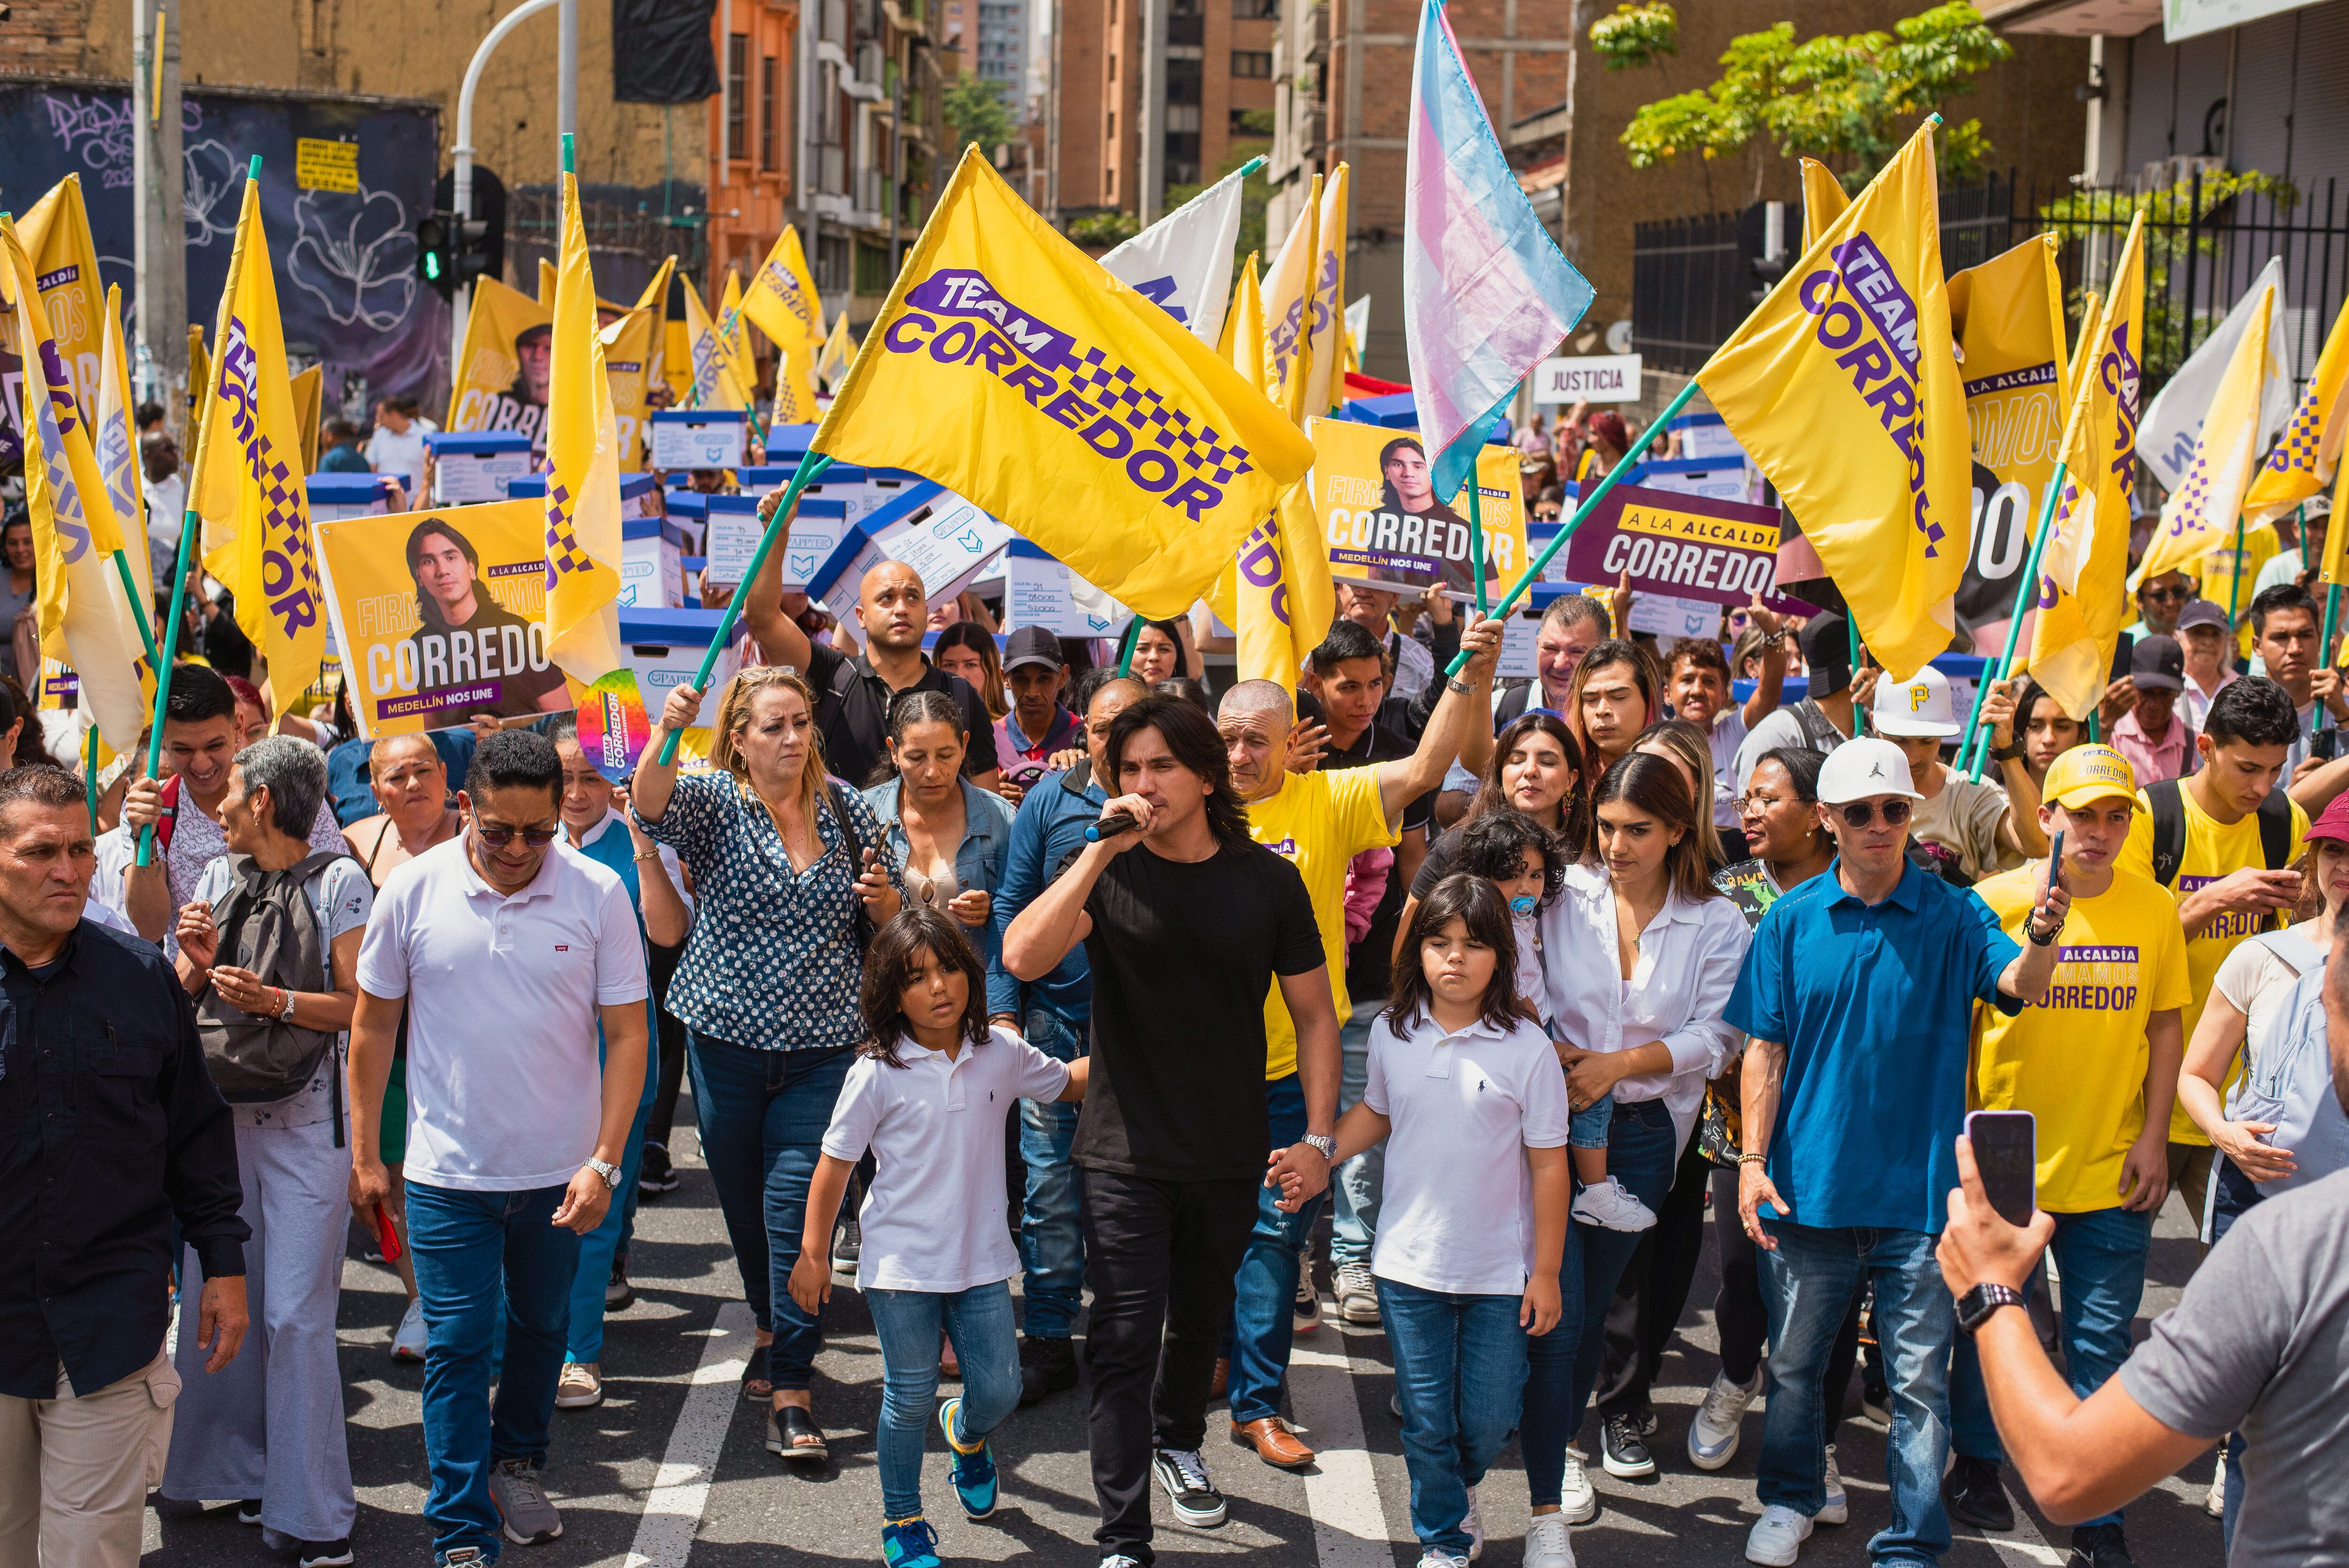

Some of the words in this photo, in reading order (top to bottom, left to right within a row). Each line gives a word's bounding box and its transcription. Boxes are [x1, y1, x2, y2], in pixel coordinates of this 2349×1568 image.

[938, 277, 1054, 353] TEAM
[1845, 245, 1918, 362] TEAM
[1552, 370, 1623, 391] JUSTICIA
[1970, 381, 1991, 394] LA
[1997, 363, 2056, 388] ALCALD
[885, 312, 1223, 522] CORREDOR
[1478, 488, 1507, 498] CALDÍA
[942, 509, 972, 535] PAPPYER
[1628, 513, 1639, 526] A
[1651, 516, 1672, 530] LA
[1682, 521, 1778, 548] ALCALDÍ
[512, 563, 545, 574] ALCALD
[1339, 552, 1388, 565] MEDELLÍN
[1390, 558, 1412, 569] NOS
[1414, 560, 1432, 572] UNE
[490, 576, 546, 616] AMO
[367, 621, 551, 695] CORREDO
[661, 674, 699, 684] PAPPY
[388, 696, 443, 714] MEDELLÍN
[446, 691, 470, 705] NOS
[472, 688, 493, 701] UNE
[1910, 684, 1929, 712] P
[608, 692, 625, 768] CORREDOR
[604, 740, 612, 764] TEAM
[683, 759, 709, 769] ALCA
[2185, 880, 2193, 890] A
[2063, 947, 2136, 961] ALCALDÍA
[2023, 986, 2137, 1011] ORREDOR
